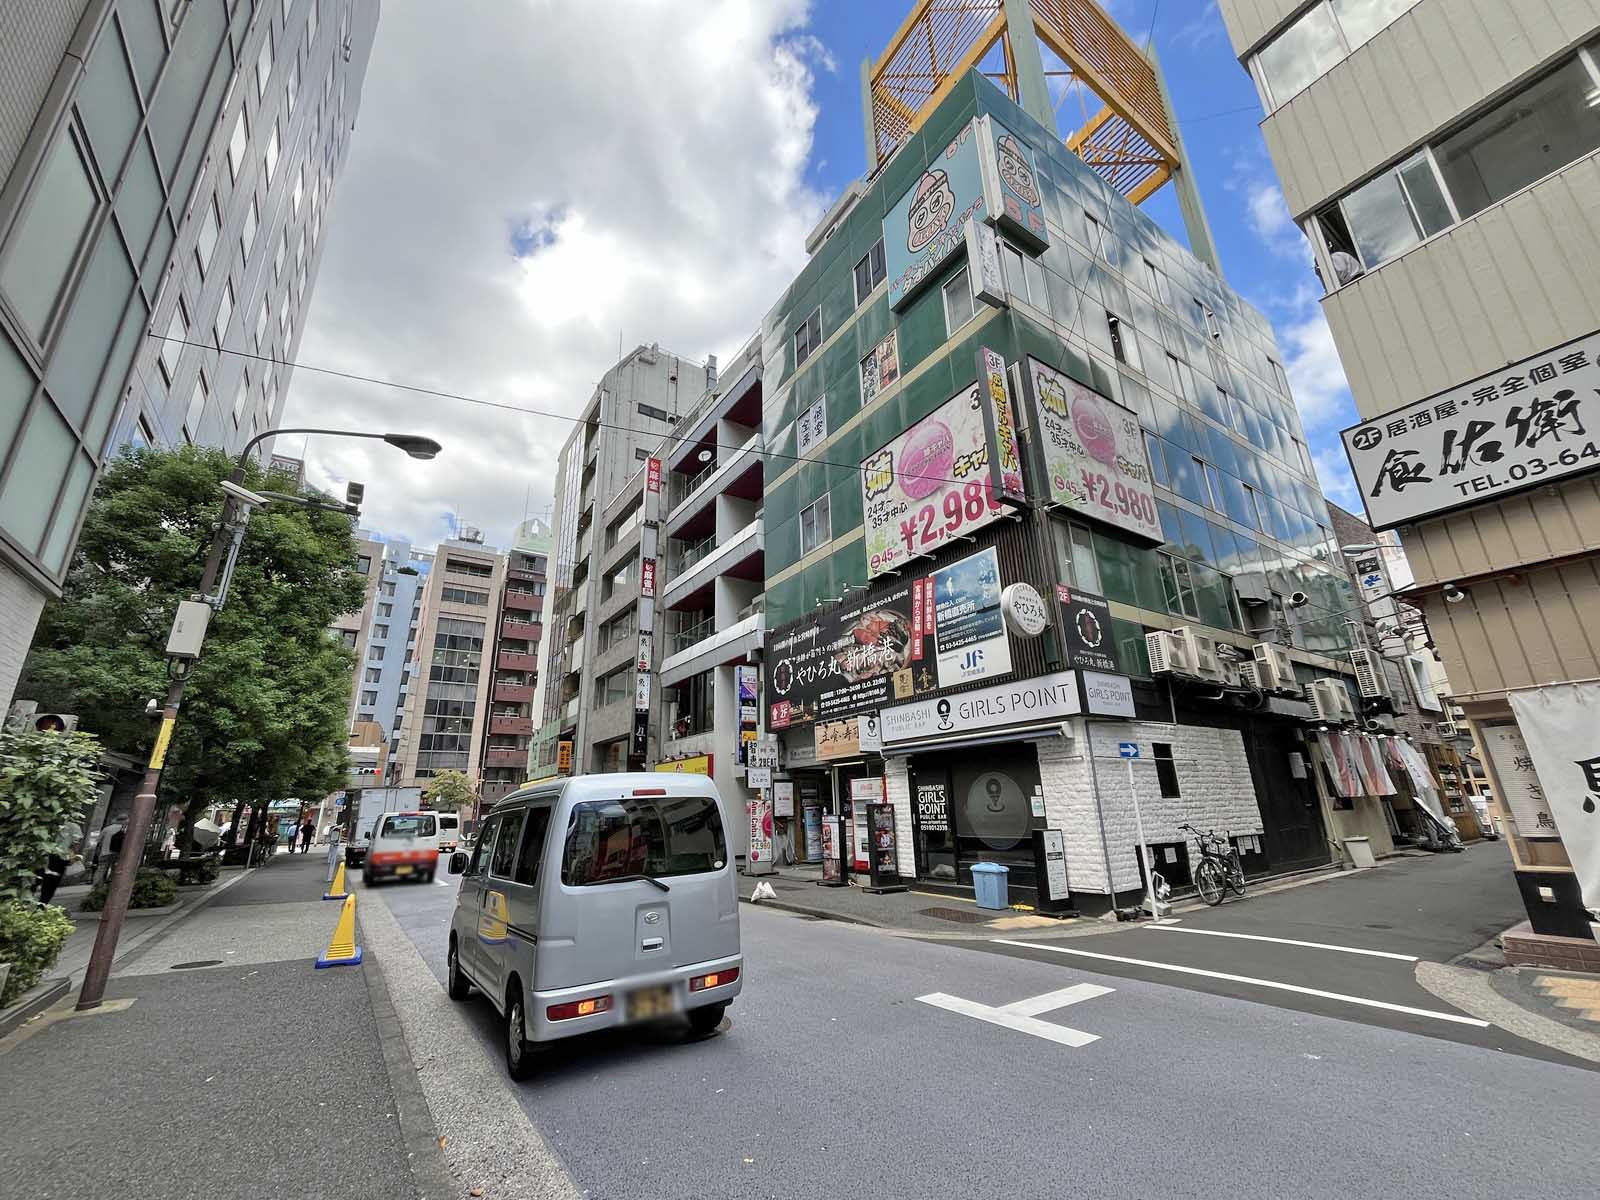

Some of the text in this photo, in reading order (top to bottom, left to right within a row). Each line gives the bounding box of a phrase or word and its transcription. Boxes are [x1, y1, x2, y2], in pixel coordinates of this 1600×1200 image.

[988, 354, 1001, 369] 3F
[1037, 372, 1068, 420] 姉
[1386, 350, 1590, 438] 居酒屋・完全個室
[1122, 418, 1137, 437] 3F
[1354, 428, 1381, 448] 2F
[865, 450, 894, 501] 姉
[1081, 468, 1156, 526] ¥2,980
[1060, 591, 1071, 602] 2F
[1013, 600, 1046, 620] やひろ丸
[796, 655, 841, 685] やひろ丸
[846, 635, 896, 672] 新橋港
[959, 683, 1070, 720] GIRLS POINT
[1088, 687, 1131, 702] GIRLS POINT
[886, 708, 931, 725] SHINBASHI
[917, 784, 945, 792] SHINBASHI
[918, 791, 945, 803] GIRLS
[1514, 756, 1556, 830] 焼き鳥
[919, 803, 946, 815] POINT
